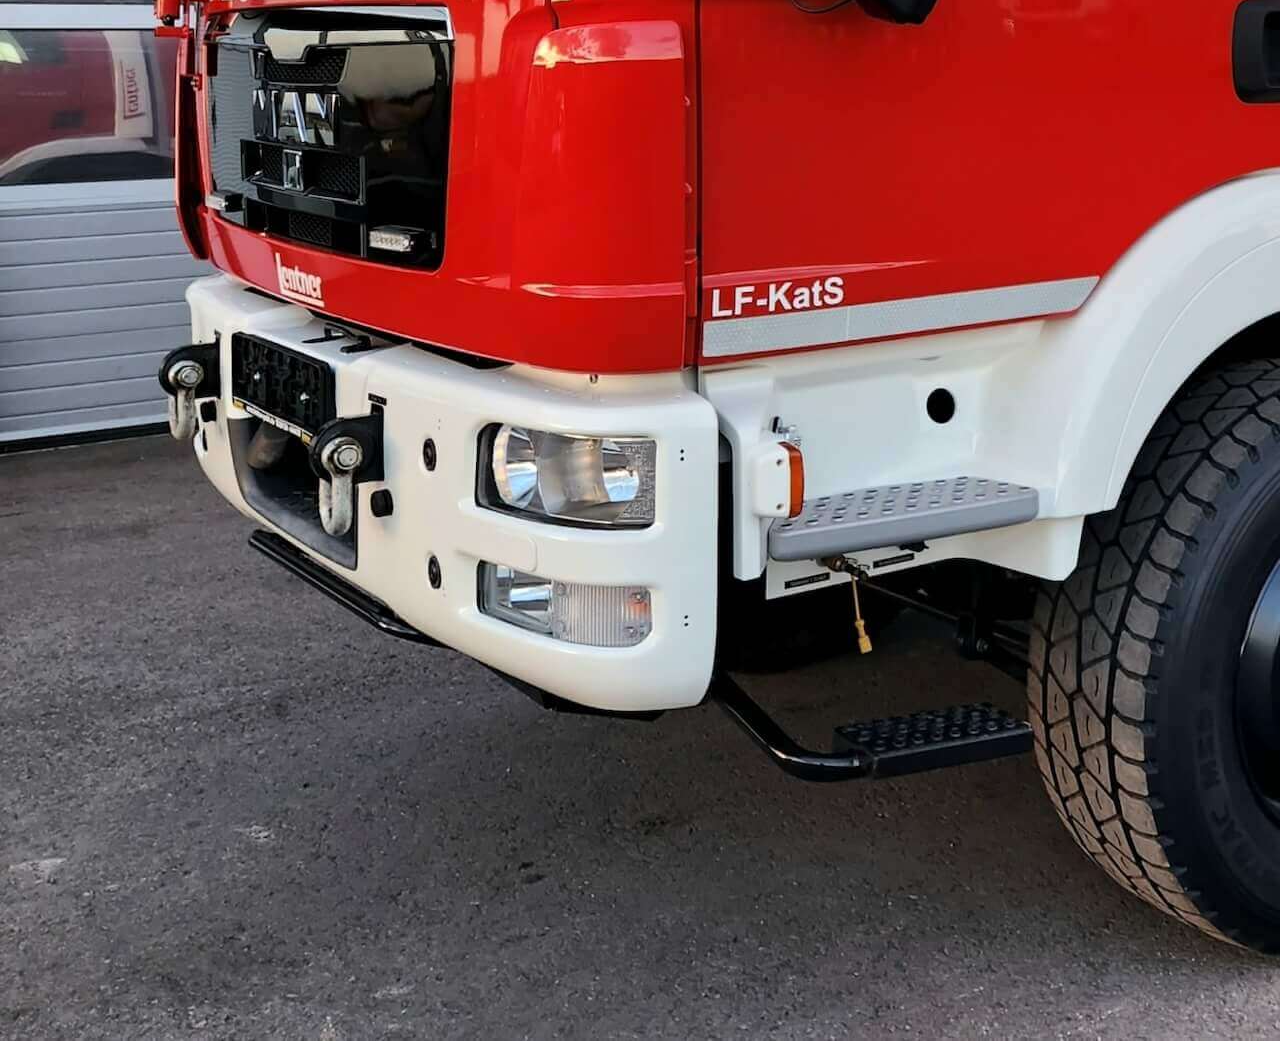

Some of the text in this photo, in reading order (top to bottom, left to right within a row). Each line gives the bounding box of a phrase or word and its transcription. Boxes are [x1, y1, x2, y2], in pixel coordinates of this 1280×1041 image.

[252, 89, 341, 146] MAN
[275, 252, 325, 308] Lentner
[711, 276, 844, 318] LF-KatS
